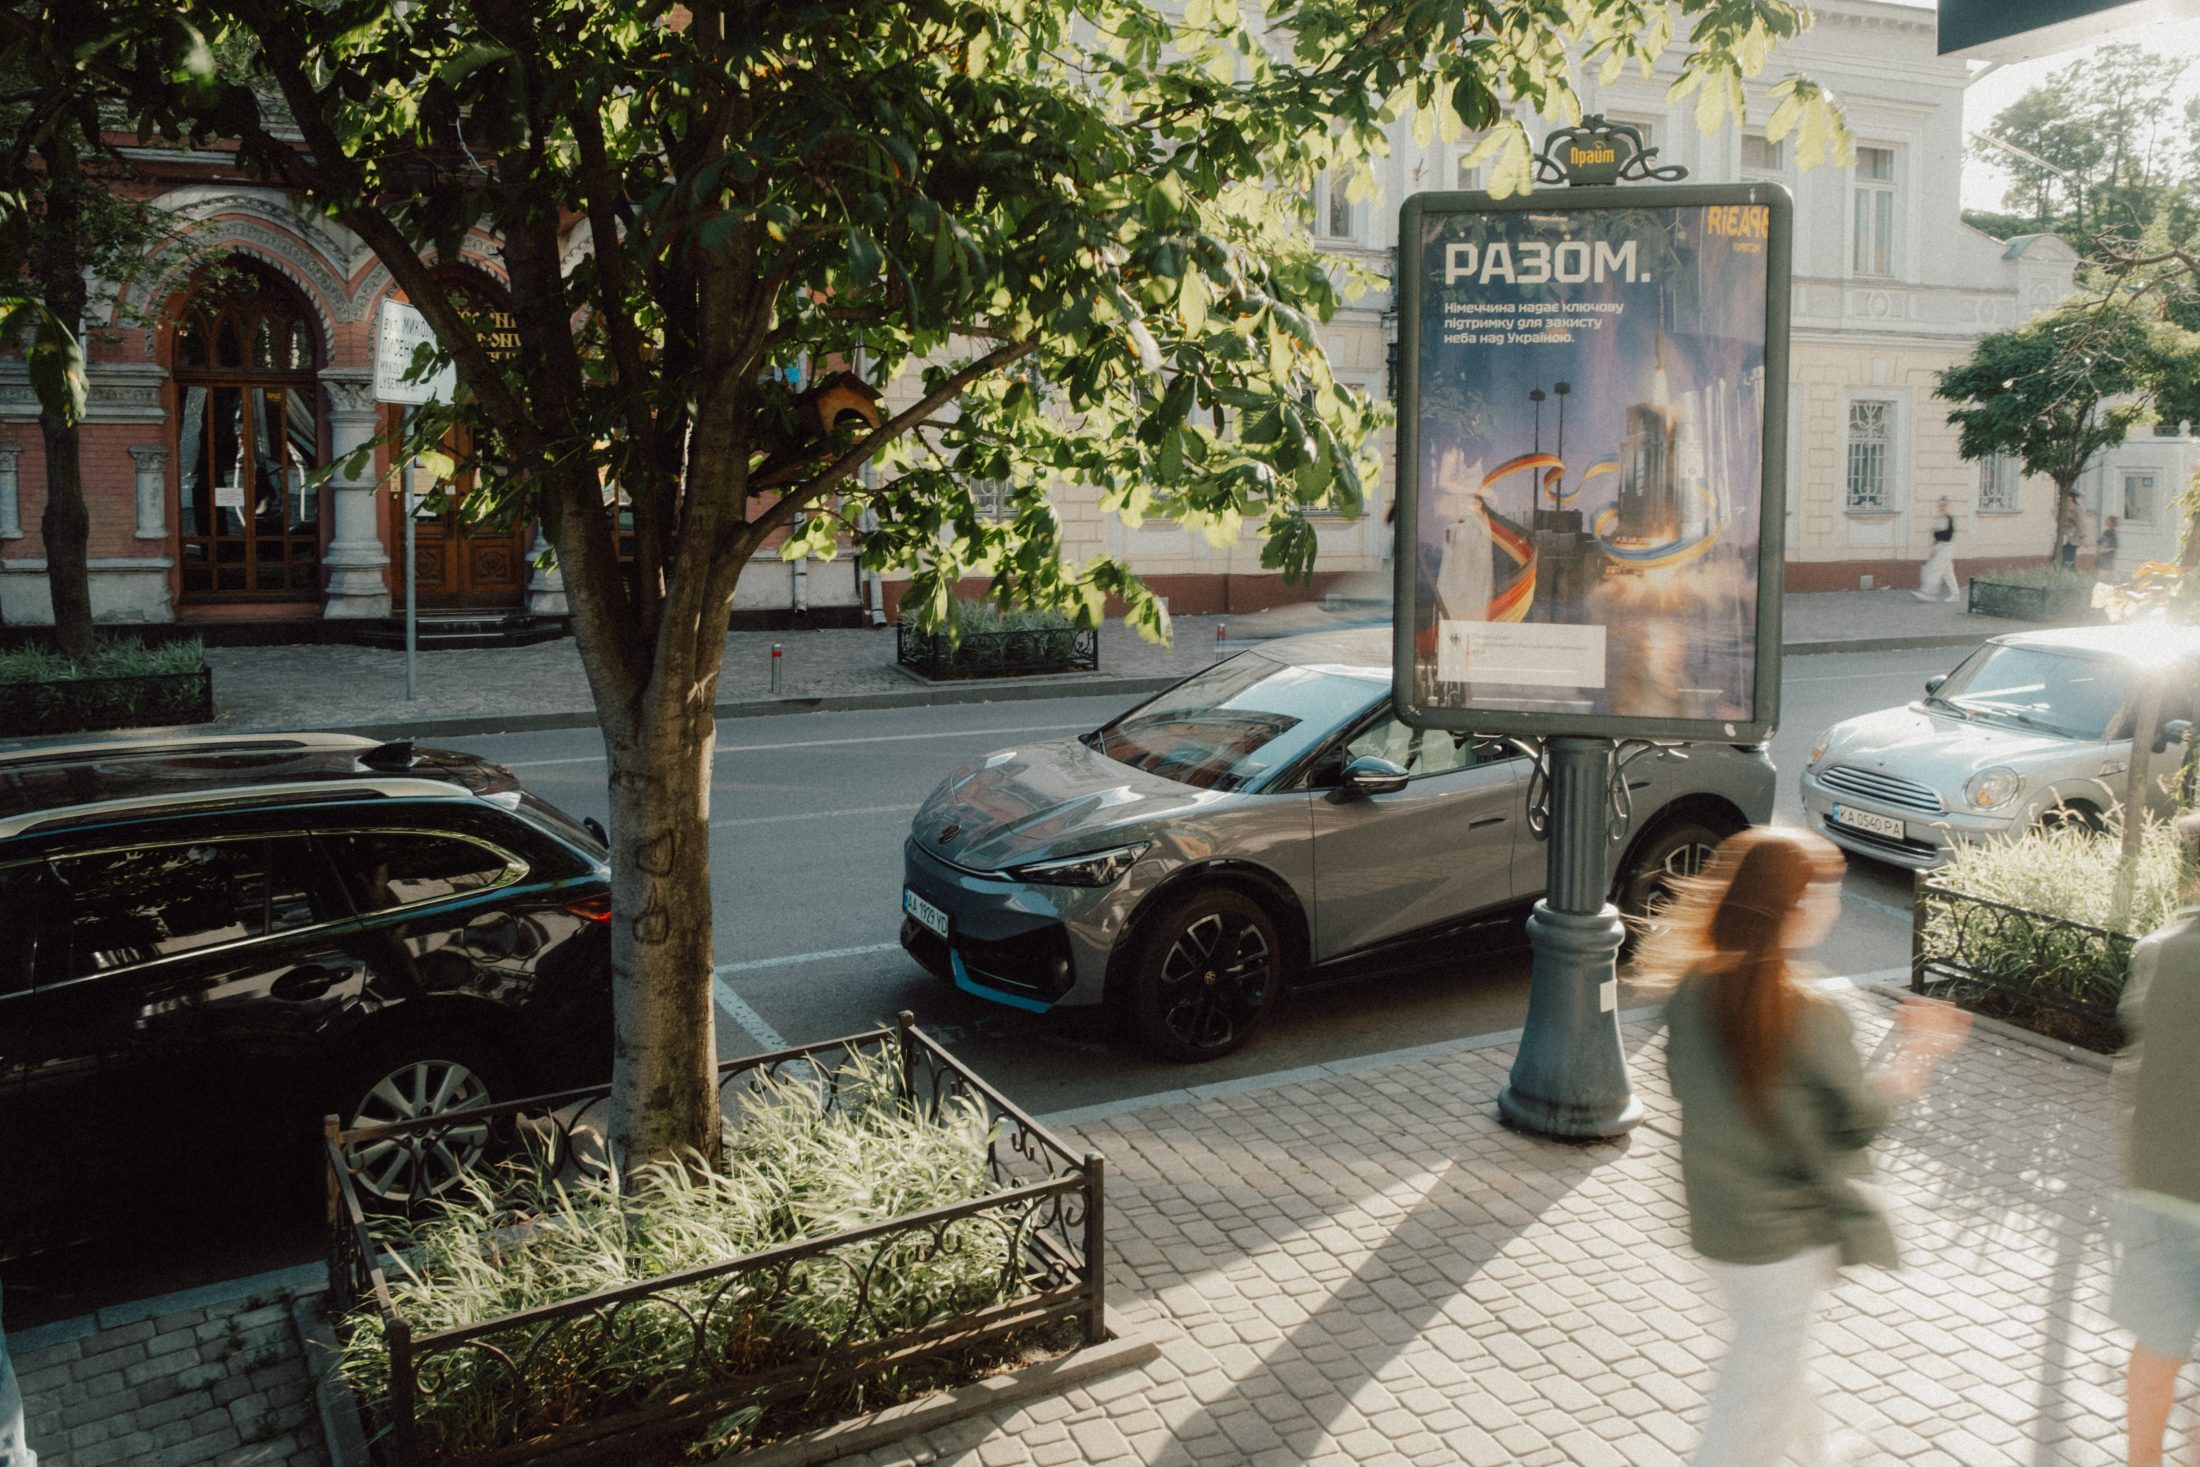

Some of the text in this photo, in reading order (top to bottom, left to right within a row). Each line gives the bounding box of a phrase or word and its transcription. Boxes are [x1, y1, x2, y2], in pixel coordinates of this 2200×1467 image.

[1445, 240, 1650, 284] РАЗОМ.
[1444, 302, 1624, 315] Німеччина надає ключову
[1444, 317, 1602, 330] підтримку для захисту
[381, 336, 414, 358] ЛИСЕН
[1444, 331, 1575, 345] неба над Україною.
[1857, 813, 1881, 831] 0540
[1884, 820, 1901, 836] PA
